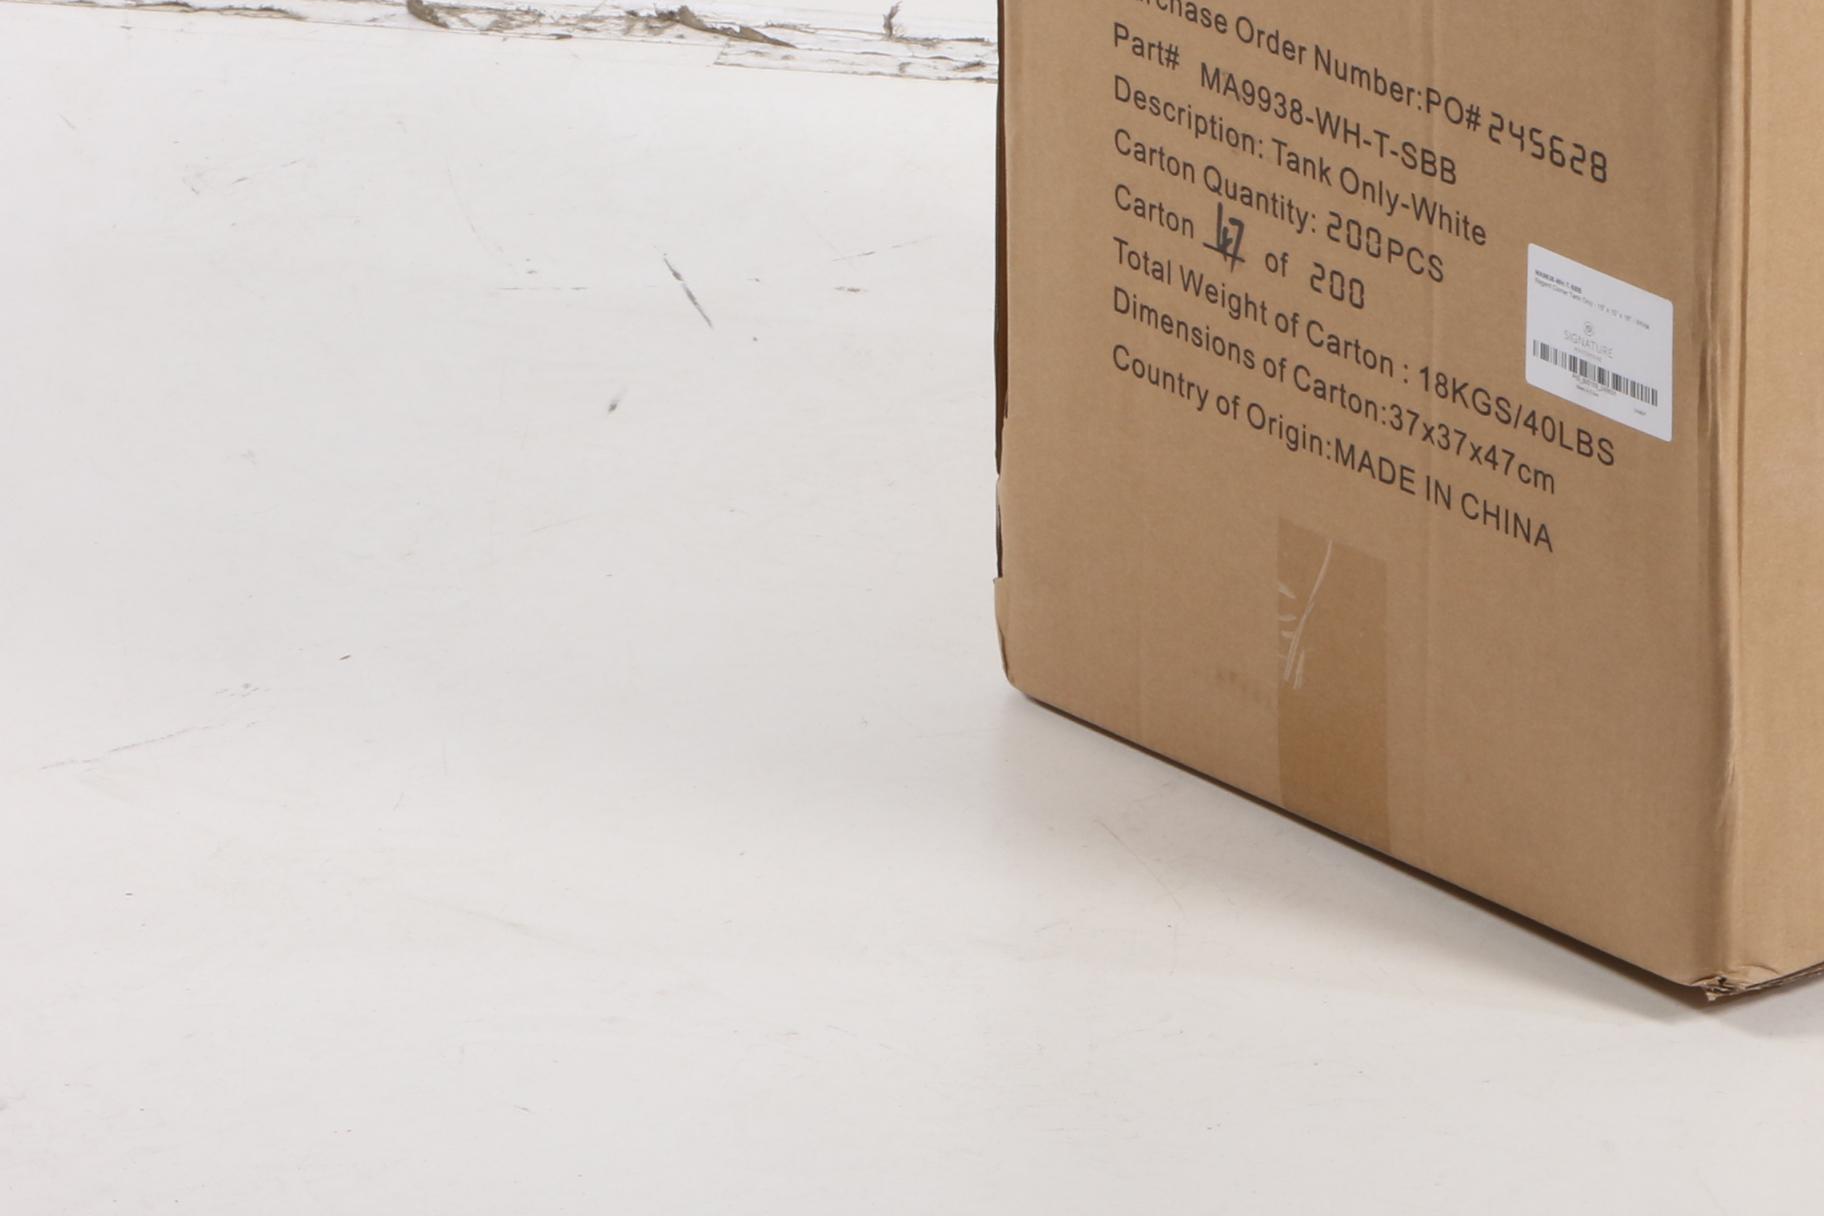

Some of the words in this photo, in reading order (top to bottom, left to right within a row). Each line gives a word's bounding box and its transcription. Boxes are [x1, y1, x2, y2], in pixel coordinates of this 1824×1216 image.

[1113, 21, 1180, 71] Part#
[1200, 61, 1457, 186] MA9938-WH-T-SBB
[1235, 15, 1308, 65] Order
[1114, 74, 1263, 159] Description:
[1271, 137, 1332, 187] Tank
[1339, 166, 1487, 247] Only-White
[1114, 128, 1195, 185] Carton
[1203, 164, 1316, 235] Quantity:
[1114, 183, 1194, 240] Carton
[1264, 251, 1289, 278] of
[1309, 261, 1365, 310] 200
[1112, 236, 1172, 286] Total
[1179, 264, 1268, 327] Weight
[1274, 311, 1300, 338] of
[1306, 319, 1394, 378] Carton
[1419, 365, 1615, 467] 18KGS/40LBS
[1113, 285, 1256, 370] Dimensions
[1262, 357, 1288, 383] of
[1112, 343, 1209, 412] Country
[1215, 394, 1241, 421] of
[1425, 474, 1452, 511] IN
[1460, 492, 1554, 553] CHINA
